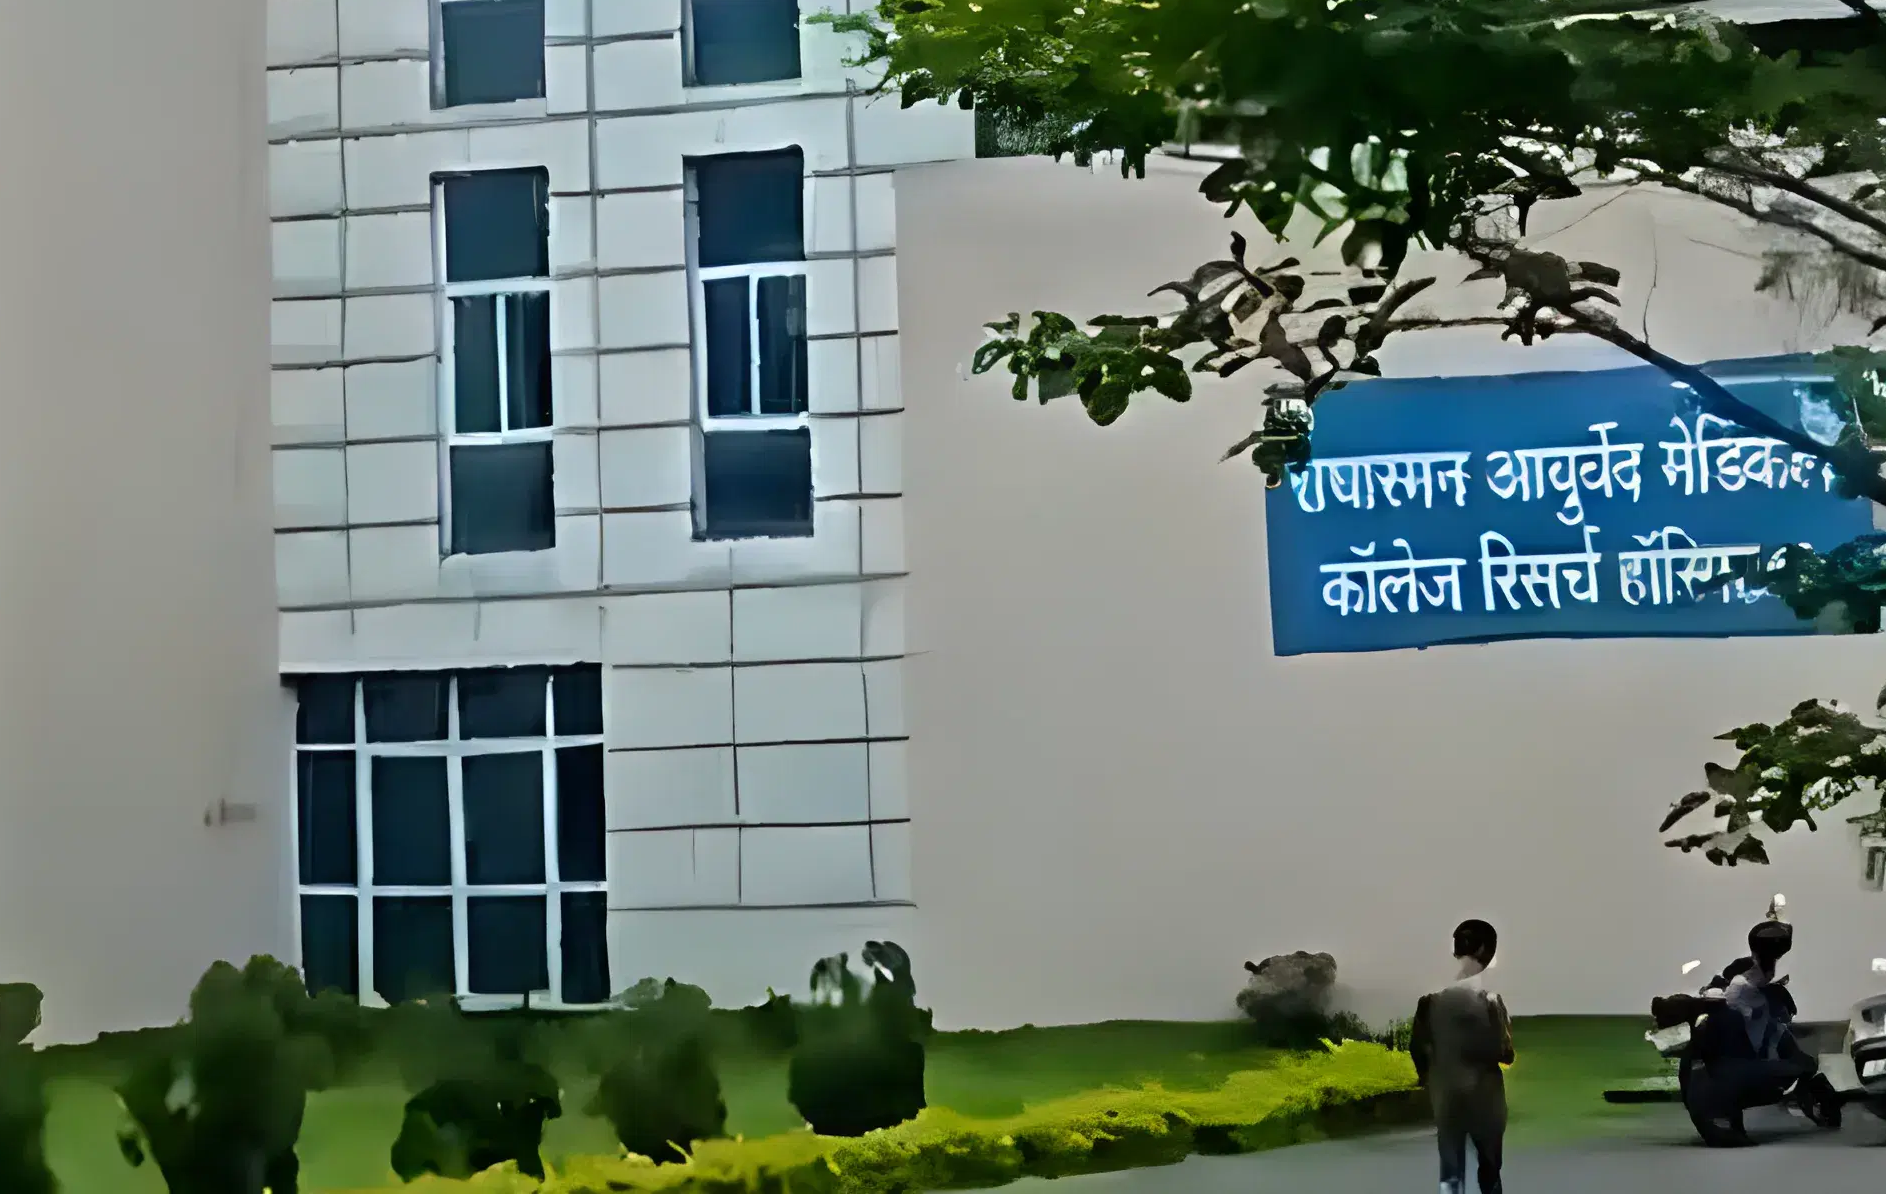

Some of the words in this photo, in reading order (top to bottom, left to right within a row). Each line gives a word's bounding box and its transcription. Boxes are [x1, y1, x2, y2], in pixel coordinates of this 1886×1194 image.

[1486, 421, 1644, 525] आयुर्वेद
[1319, 537, 1467, 616] कॉलेज
[1478, 525, 1602, 610] रिसर्च
